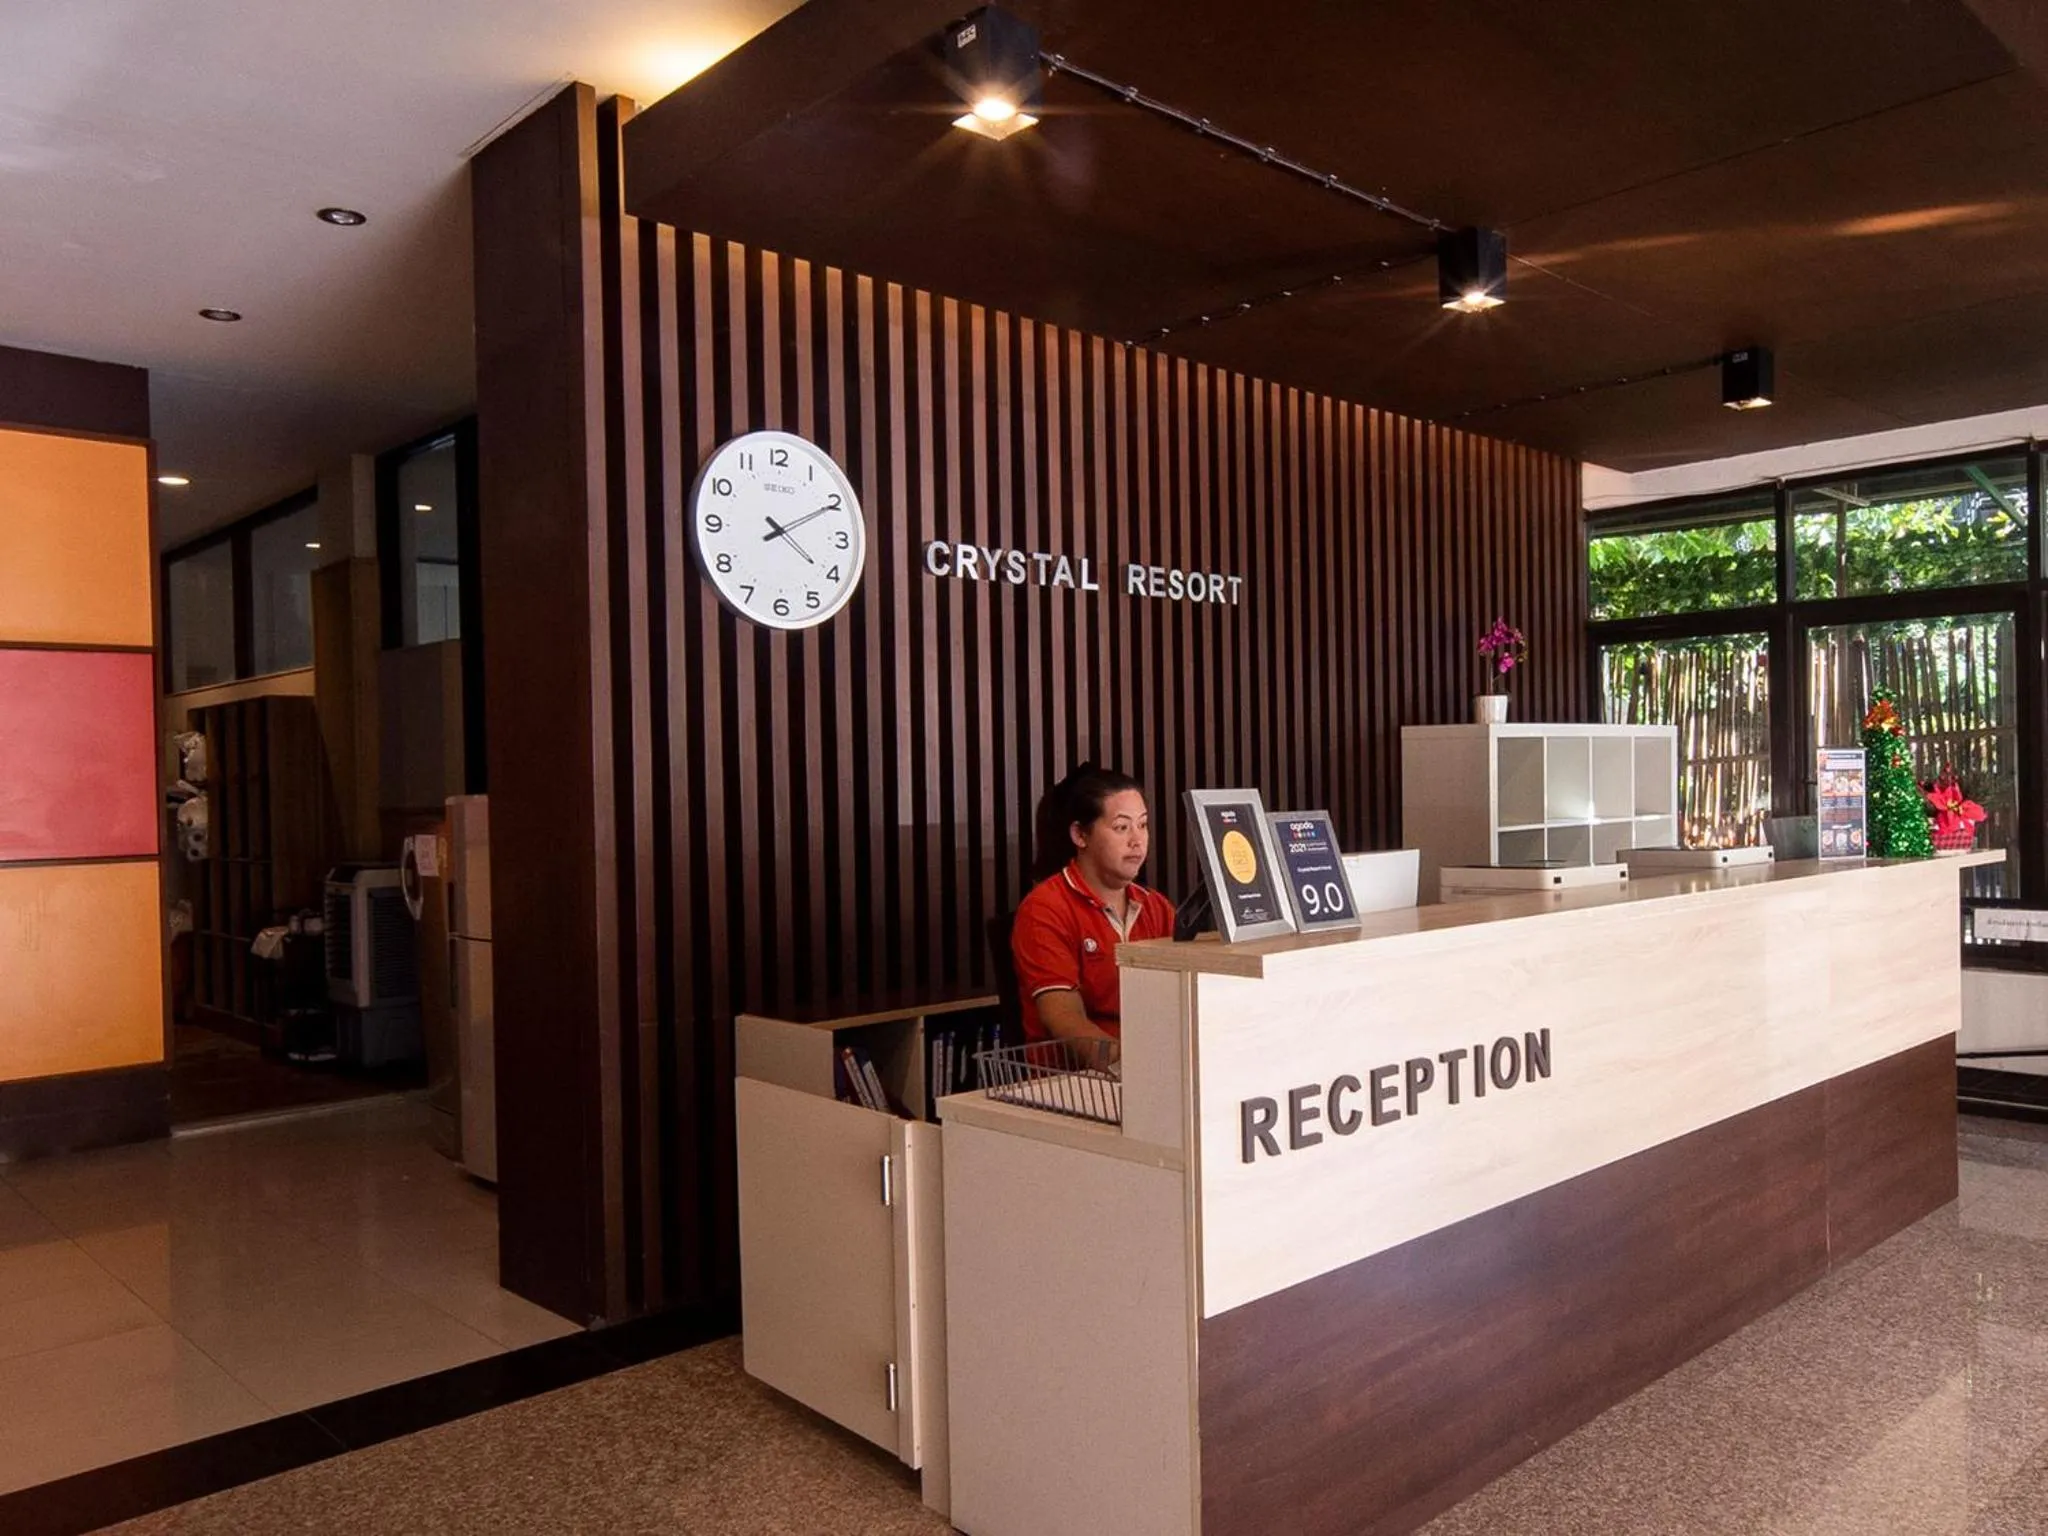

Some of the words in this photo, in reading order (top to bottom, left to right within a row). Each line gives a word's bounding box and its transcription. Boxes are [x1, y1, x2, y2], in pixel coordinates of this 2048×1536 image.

[739, 452, 752, 471] 11
[769, 449, 788, 467] 12
[808, 465, 814, 482] 1
[712, 477, 732, 496] 10
[827, 493, 842, 511] 2
[705, 514, 722, 533] 9
[835, 531, 849, 550] 3
[716, 553, 732, 573] 8
[926, 540, 1100, 591] CRYSTAL
[1127, 563, 1242, 605] RESORT
[826, 565, 840, 583] 4
[739, 584, 755, 604] 7
[805, 591, 821, 609] 5
[773, 598, 790, 617] 6
[1301, 882, 1344, 915] 9.0
[1240, 1028, 1551, 1164] RECEPTION
